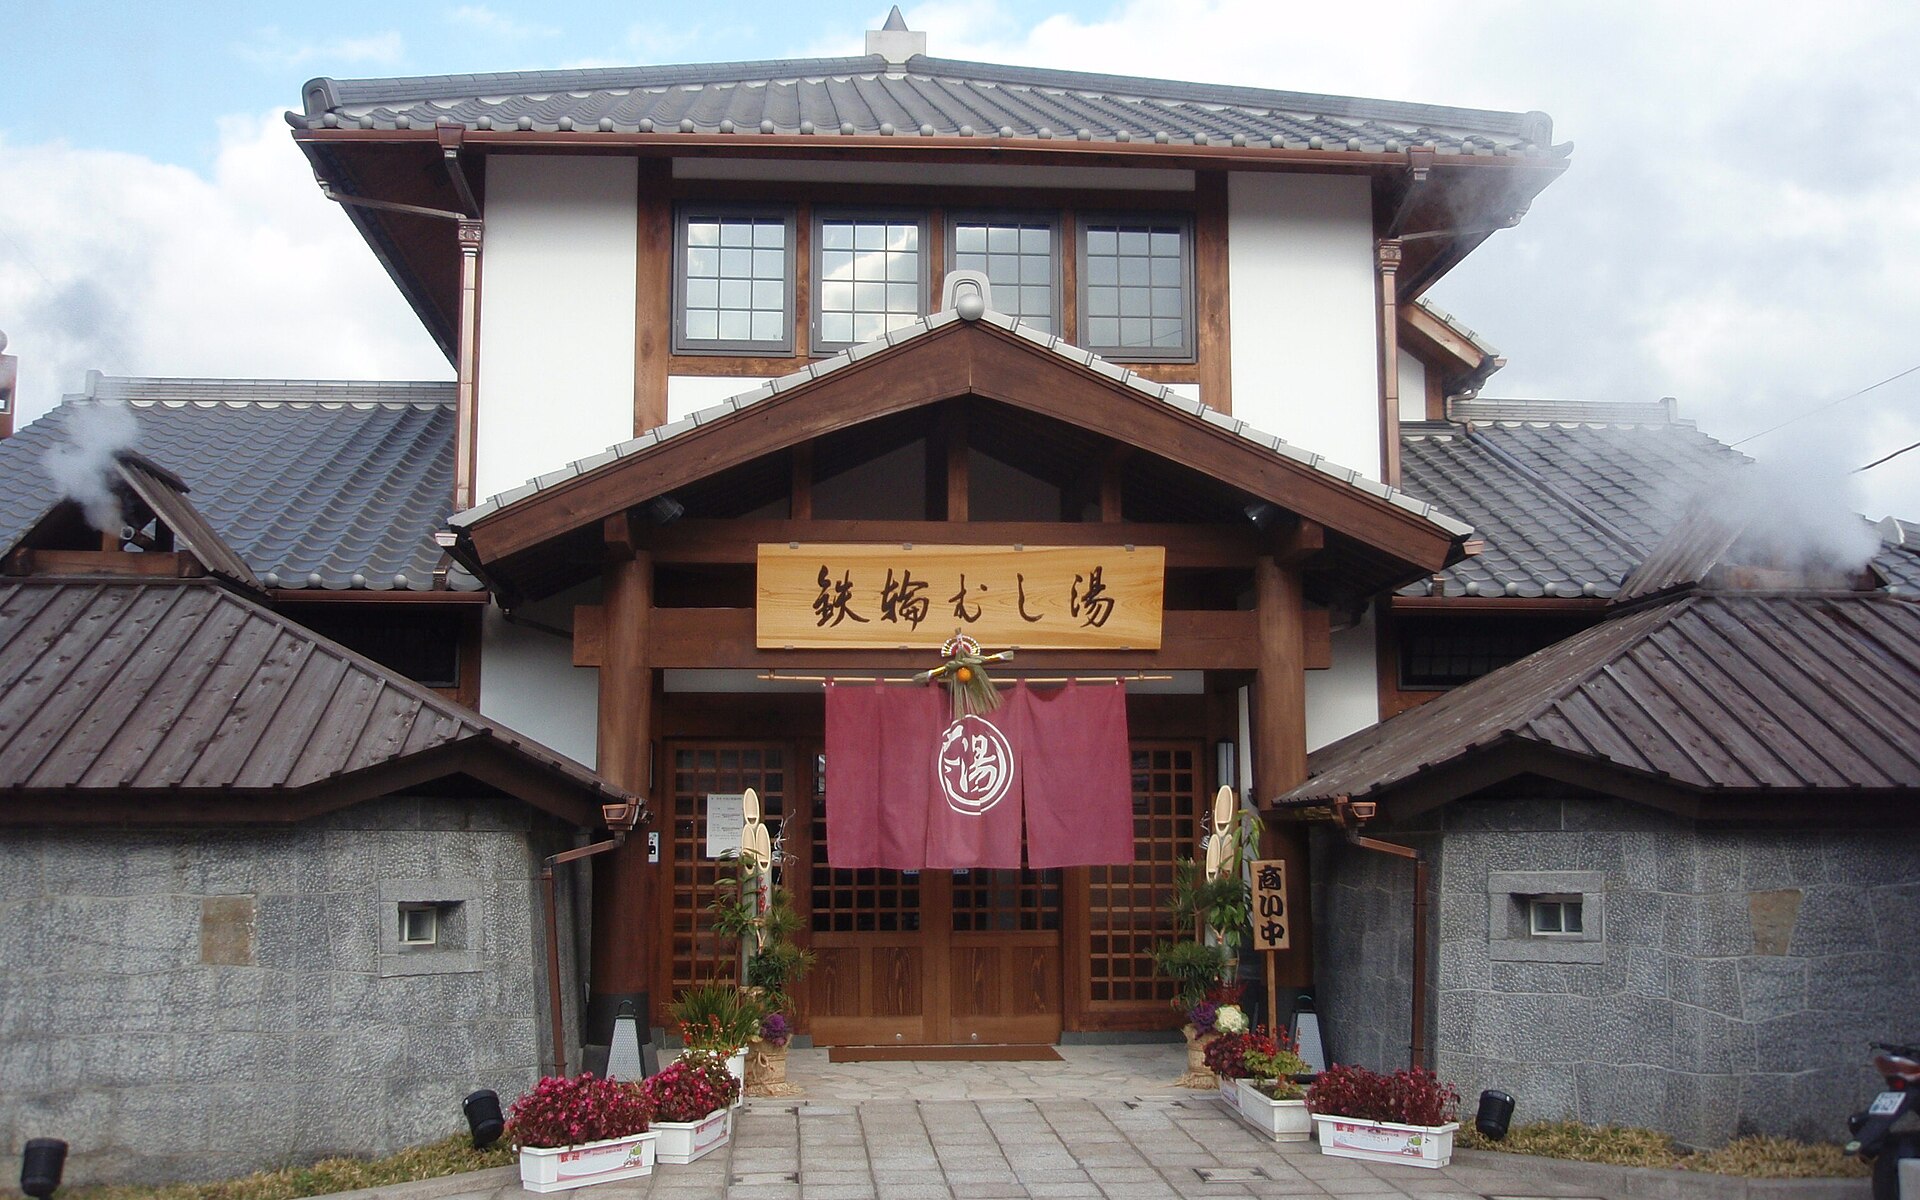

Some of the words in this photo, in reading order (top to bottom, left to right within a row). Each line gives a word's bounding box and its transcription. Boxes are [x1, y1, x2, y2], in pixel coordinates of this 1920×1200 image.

[814, 564, 1115, 632] 鉄輪むし湯
[1257, 864, 1285, 946] 商い中
